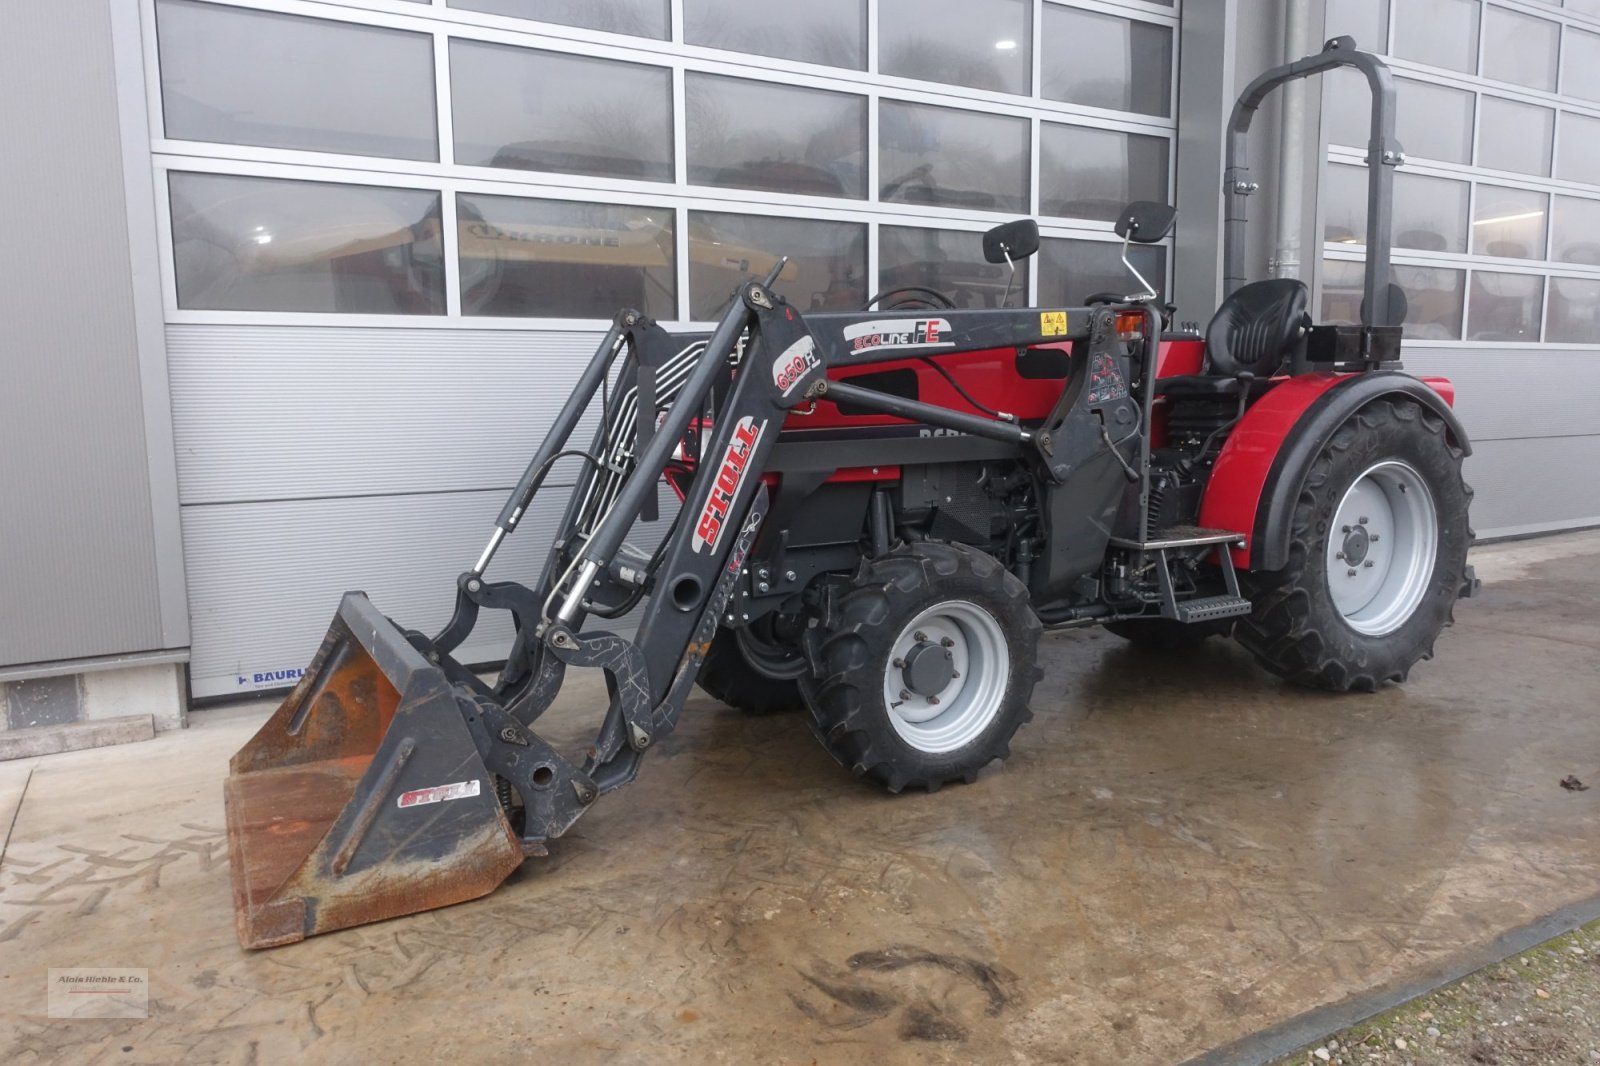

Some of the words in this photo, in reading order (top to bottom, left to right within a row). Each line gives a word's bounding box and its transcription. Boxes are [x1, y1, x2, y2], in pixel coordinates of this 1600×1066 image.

[912, 320, 940, 343] FE
[697, 423, 759, 546] STOLL
[253, 668, 308, 684] BÄURL
